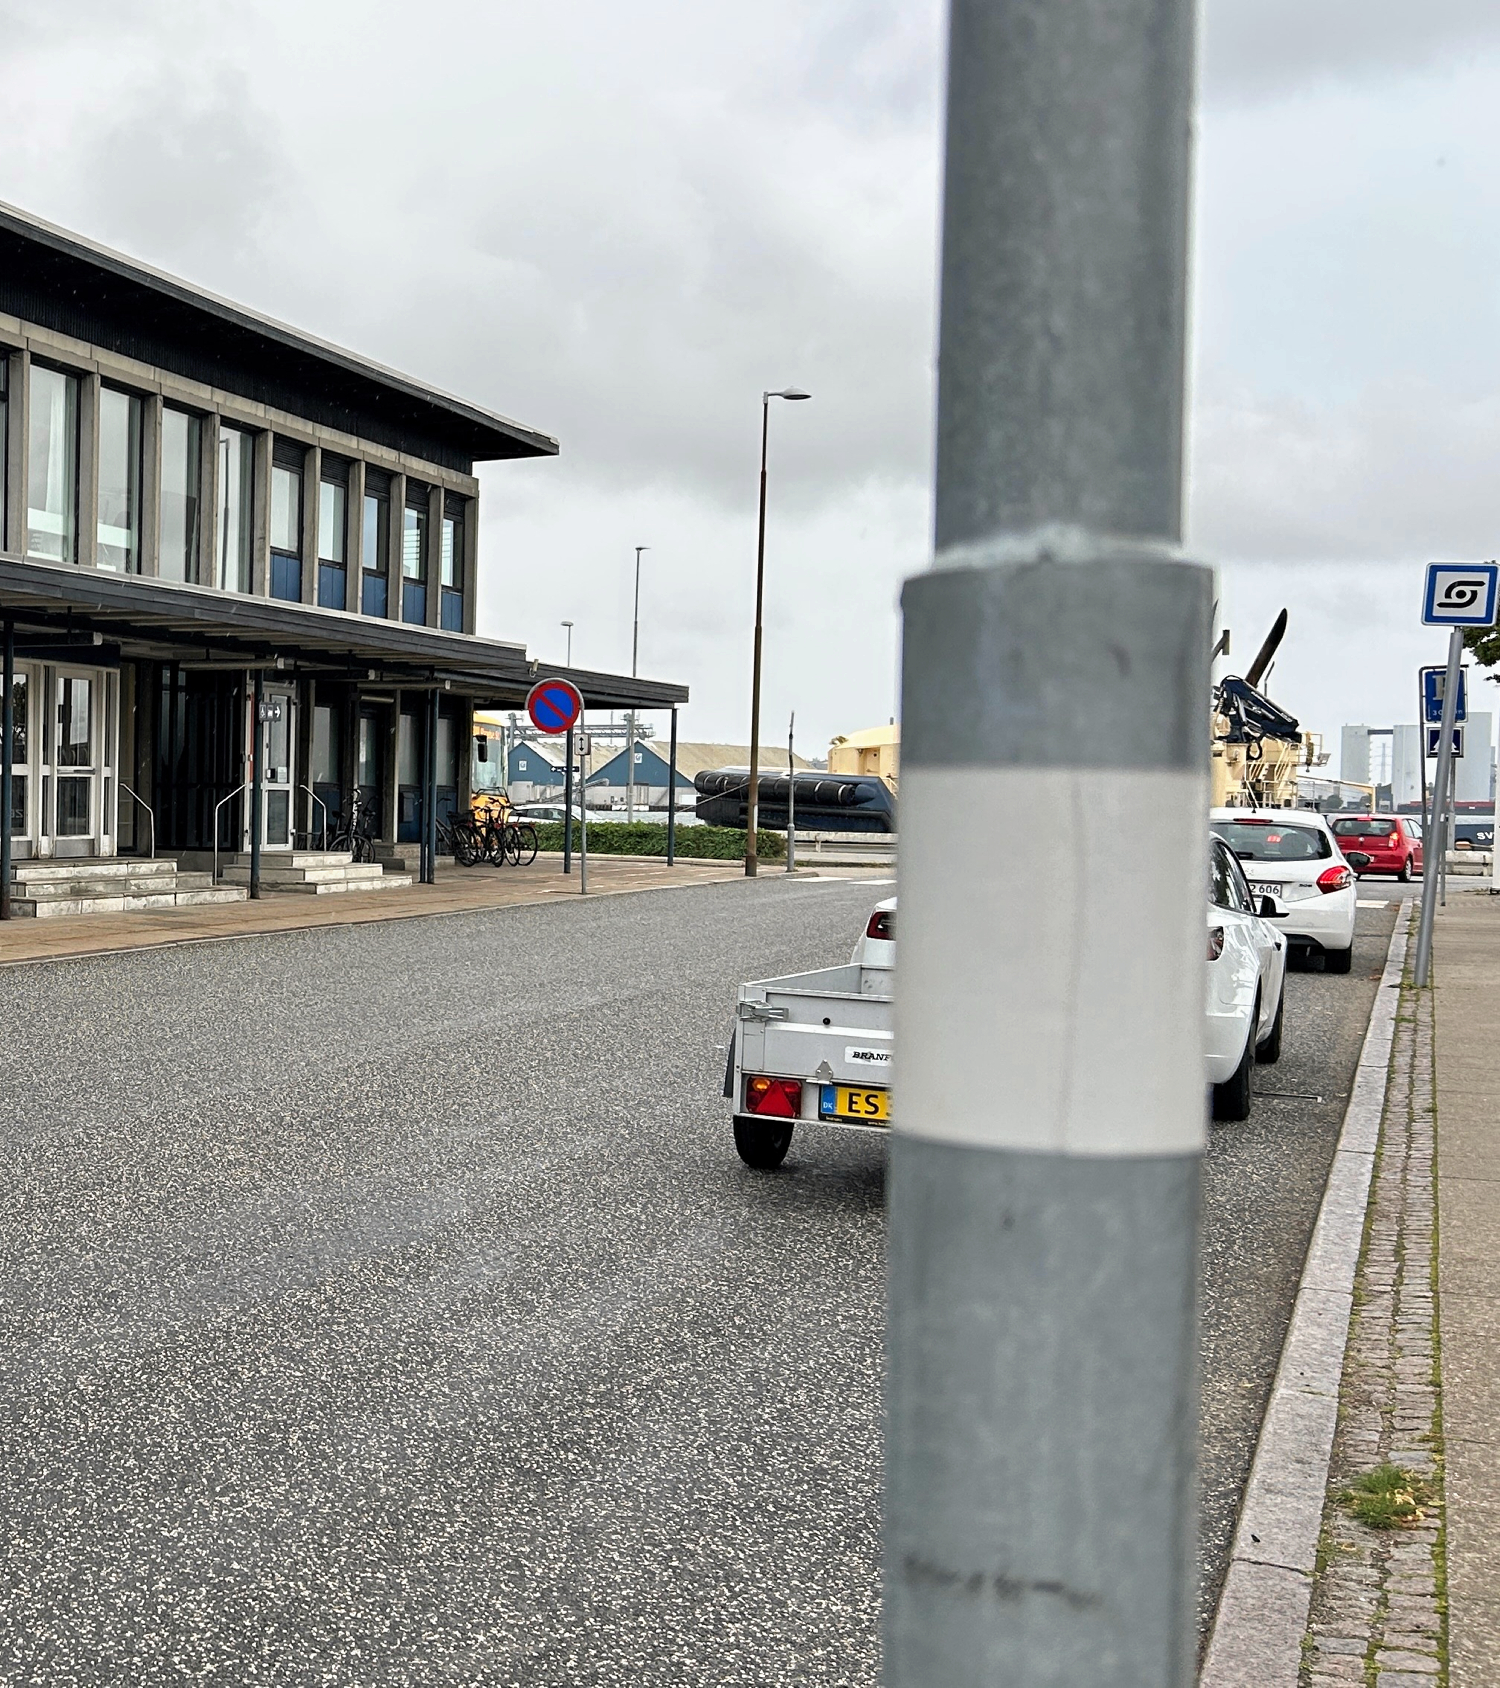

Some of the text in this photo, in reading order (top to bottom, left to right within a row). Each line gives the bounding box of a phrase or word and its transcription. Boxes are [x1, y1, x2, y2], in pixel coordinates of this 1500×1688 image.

[1258, 884, 1280, 895] 606
[823, 1101, 833, 1109] DK
[848, 1092, 880, 1115] ES
